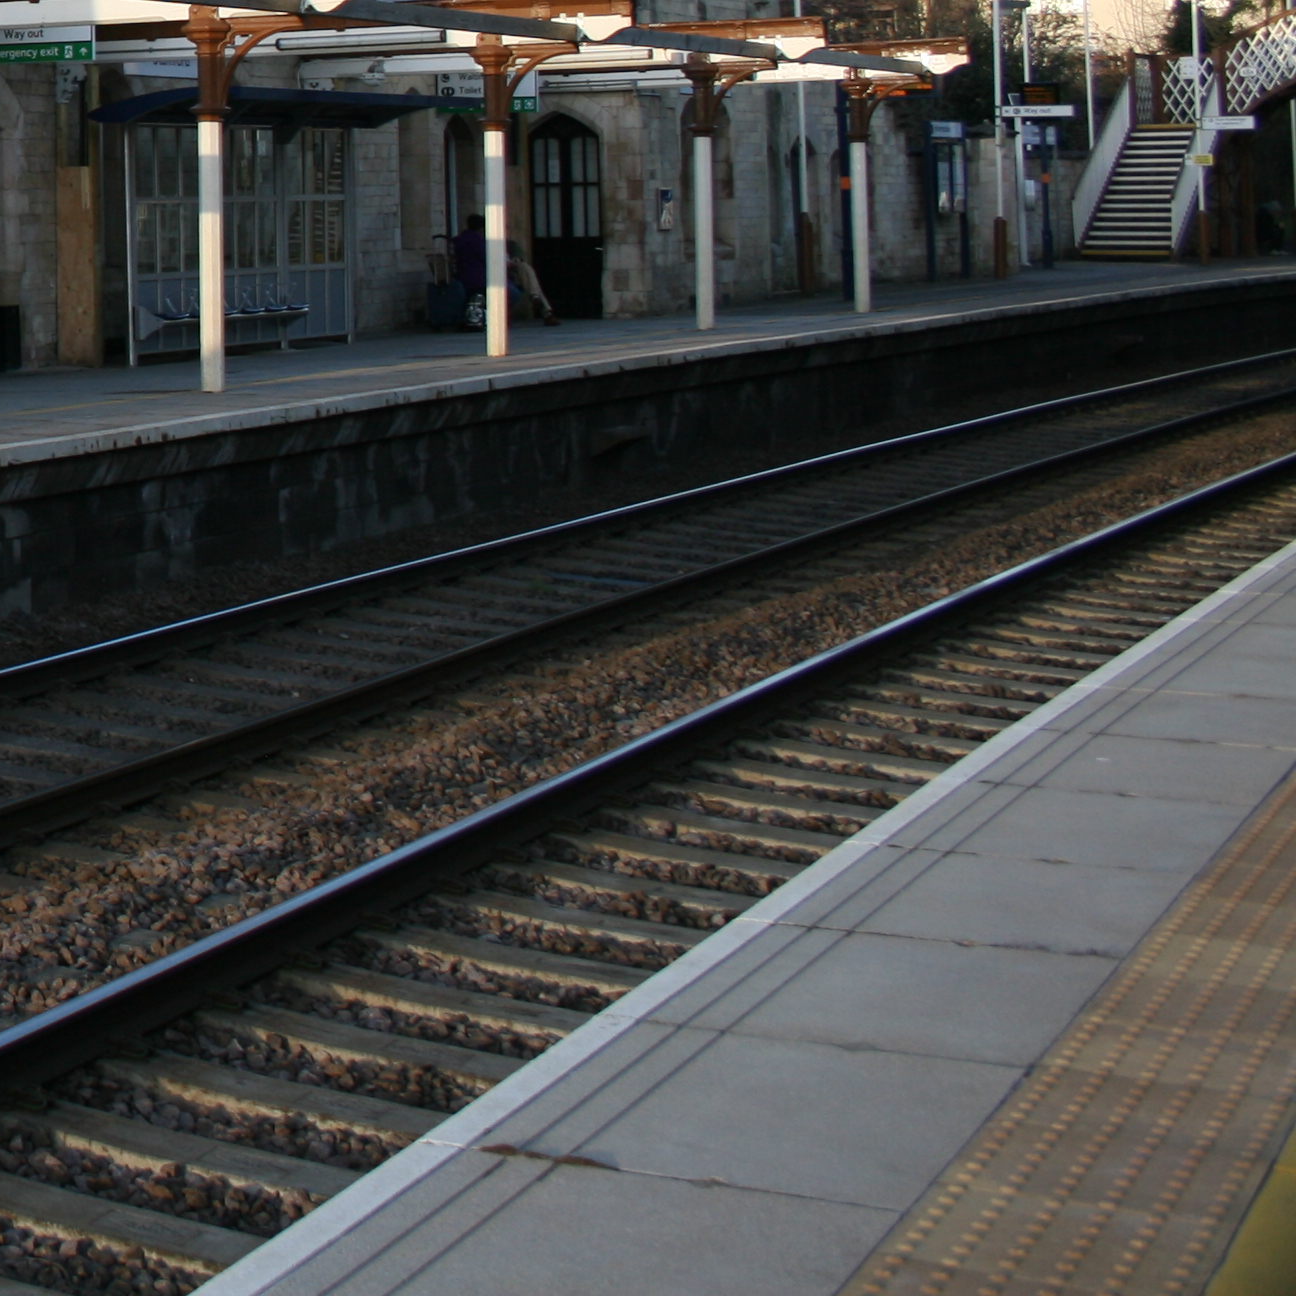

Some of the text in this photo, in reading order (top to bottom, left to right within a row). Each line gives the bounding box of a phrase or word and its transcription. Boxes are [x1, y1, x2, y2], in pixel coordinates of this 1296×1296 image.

[3, 29, 44, 40] Way out
[39, 47, 60, 57] exit
[459, 86, 482, 94] Toilet
